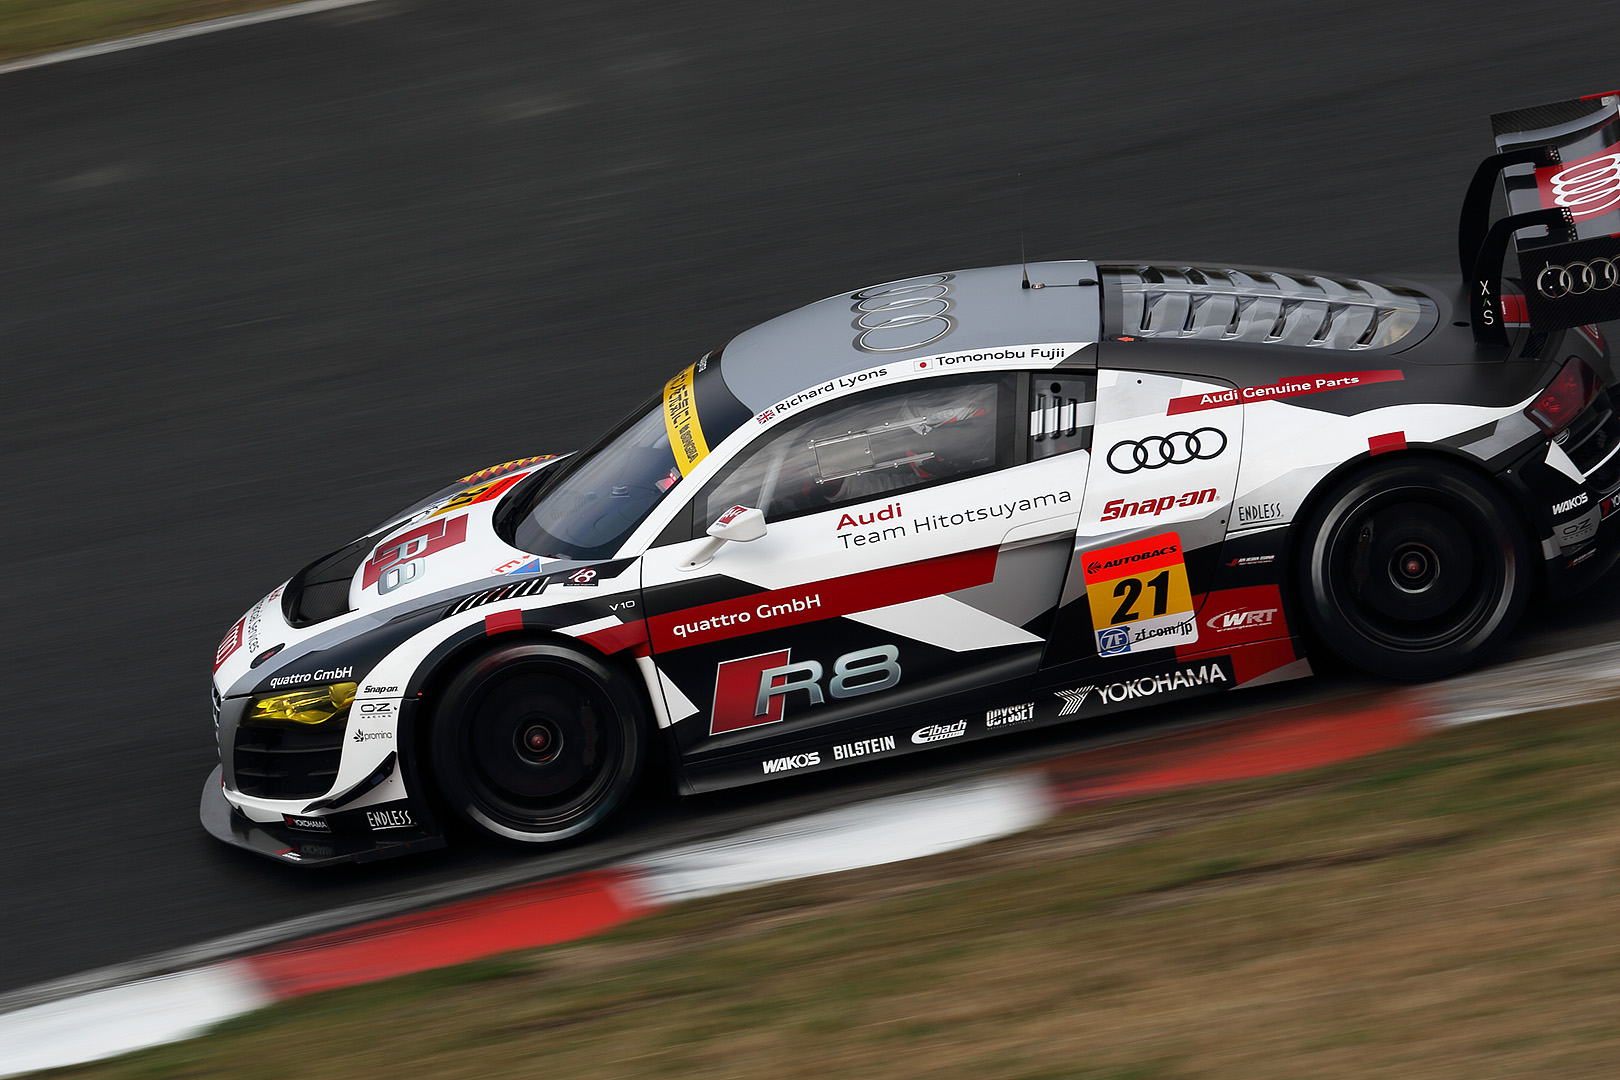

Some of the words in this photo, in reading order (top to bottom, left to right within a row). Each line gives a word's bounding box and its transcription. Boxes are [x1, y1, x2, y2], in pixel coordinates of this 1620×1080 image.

[936, 348, 1026, 366] Tomonobu
[1031, 348, 1065, 361] Fujii
[775, 383, 835, 414] Richard
[839, 367, 888, 388] Lyons
[1199, 390, 1239, 405] Audi
[1242, 380, 1311, 399] Genuine
[1316, 374, 1360, 388] Parts
[836, 503, 903, 530] Audi
[1100, 488, 1217, 522] Snap-on
[1238, 502, 1282, 522] ENDLESS
[837, 524, 905, 549] Team
[914, 490, 1072, 534] Hitotsuyama
[1103, 545, 1177, 569] AUTOBACS
[1110, 570, 1170, 625] 21
[672, 611, 752, 638] quattro
[756, 594, 822, 619] GmbH
[1223, 608, 1278, 627] WRT
[1105, 633, 1123, 650] ZF
[1134, 621, 1193, 641] zf.com/jp
[270, 672, 312, 688] quattro
[313, 666, 353, 681] GmbH
[364, 685, 399, 694] Snap-on
[753, 644, 902, 718] R8
[1094, 663, 1227, 704] YOKOHAMA
[986, 702, 1035, 727] ODYSSEY
[364, 731, 393, 741] promina
[911, 719, 968, 744] Eibach
[833, 735, 896, 760] BILSTEIN
[366, 810, 412, 828] ENDLESS
